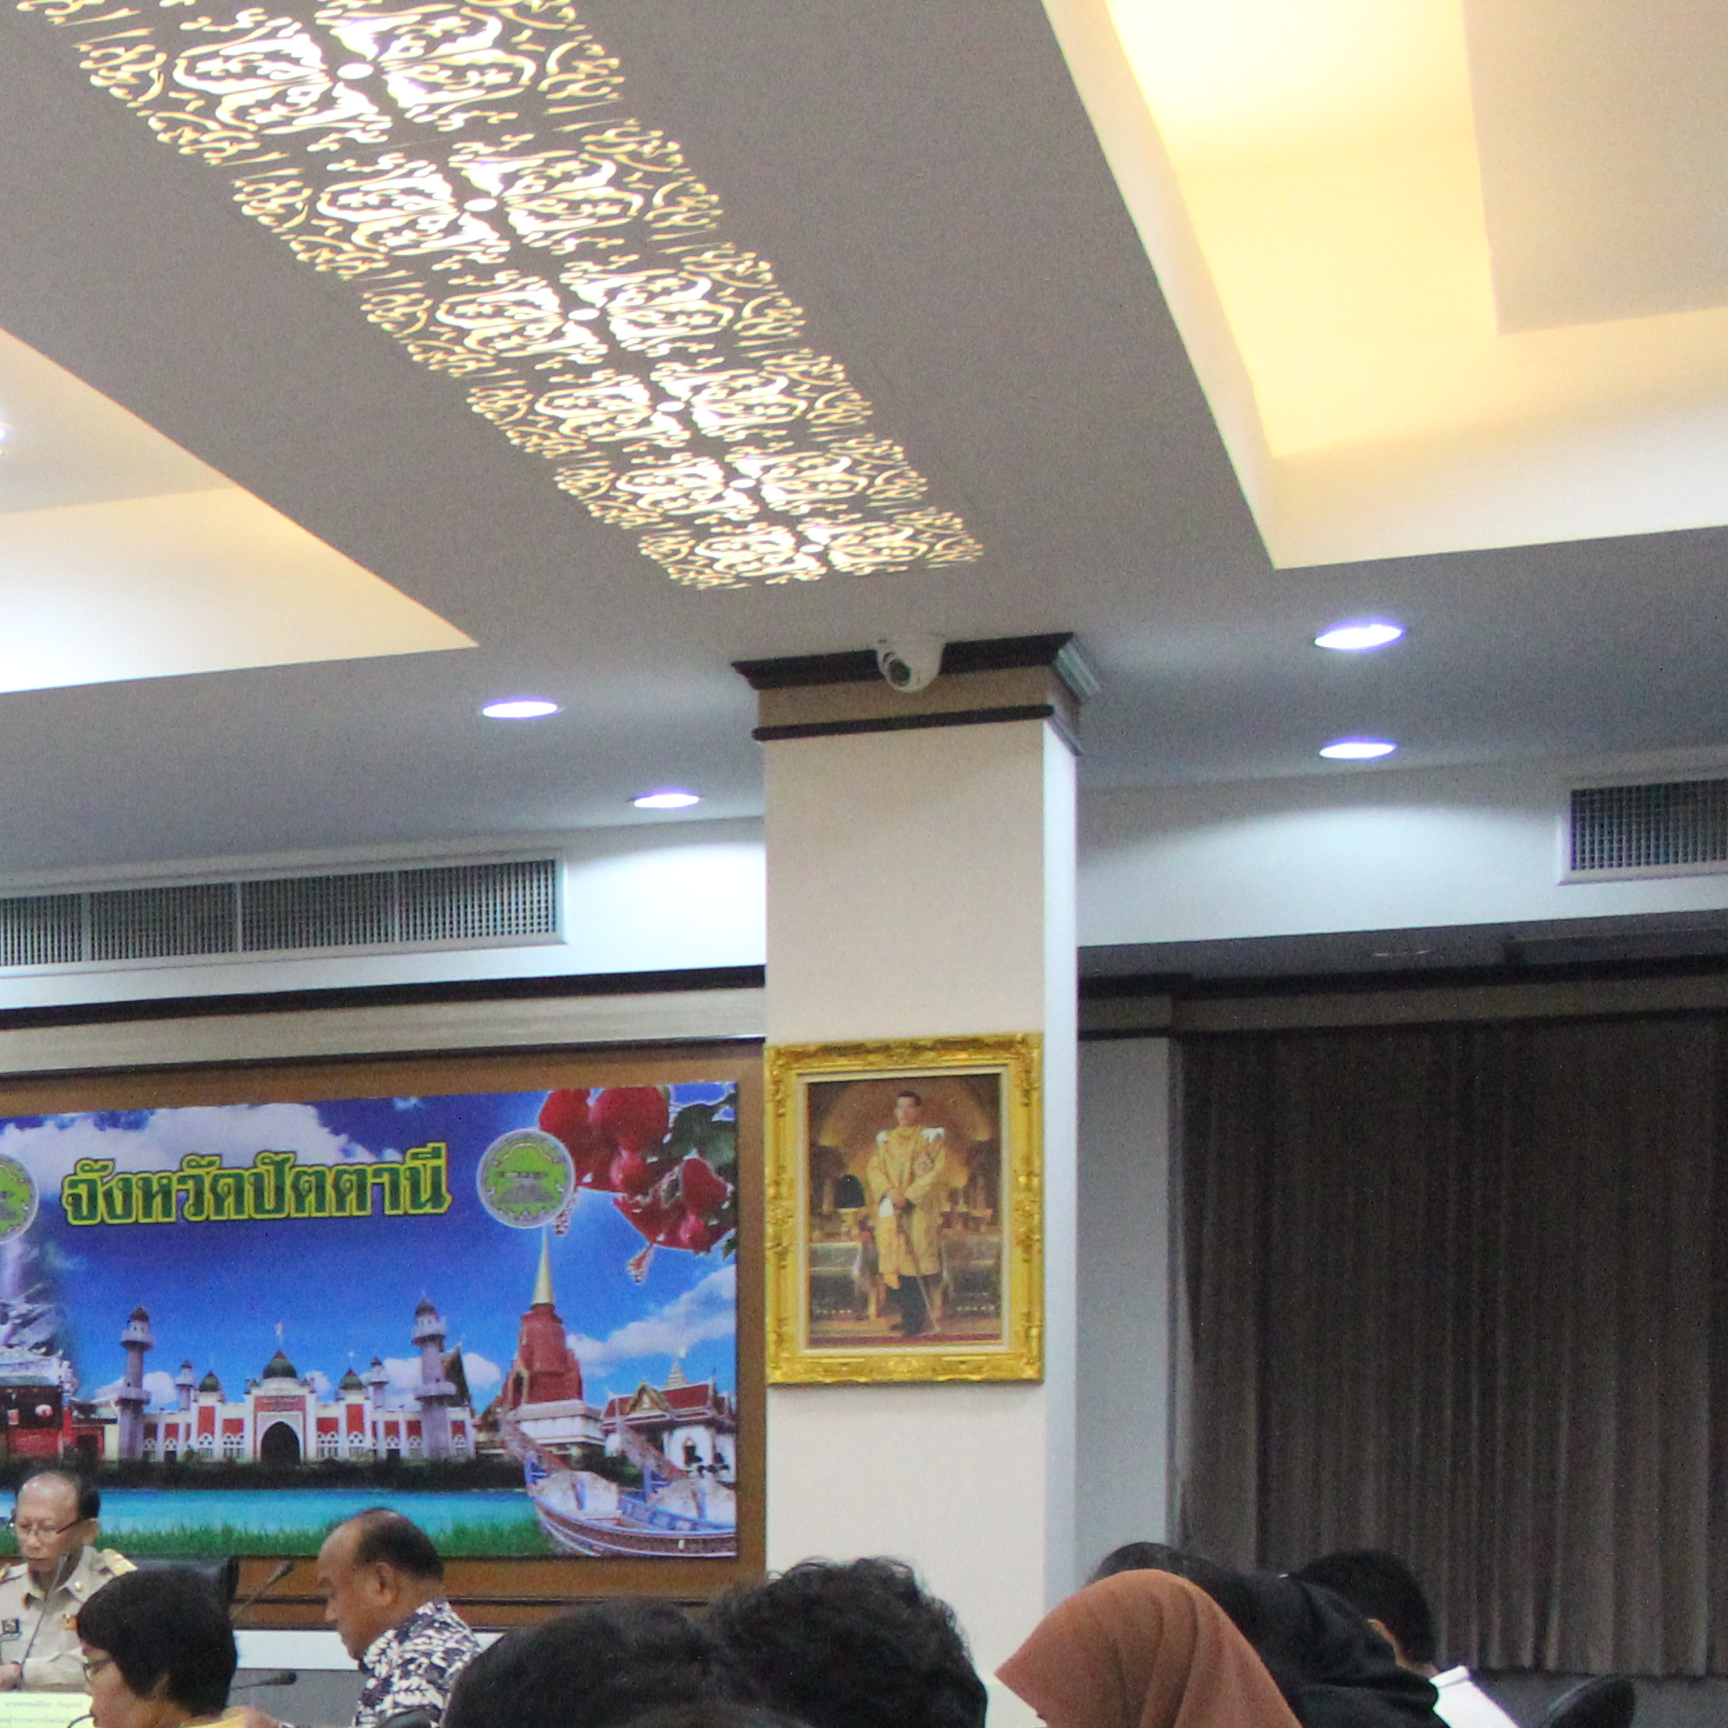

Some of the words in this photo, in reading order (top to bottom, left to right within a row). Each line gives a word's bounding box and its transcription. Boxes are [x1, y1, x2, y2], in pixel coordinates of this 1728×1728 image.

[61, 1141, 453, 1226] จังหวัดปัตตานี
